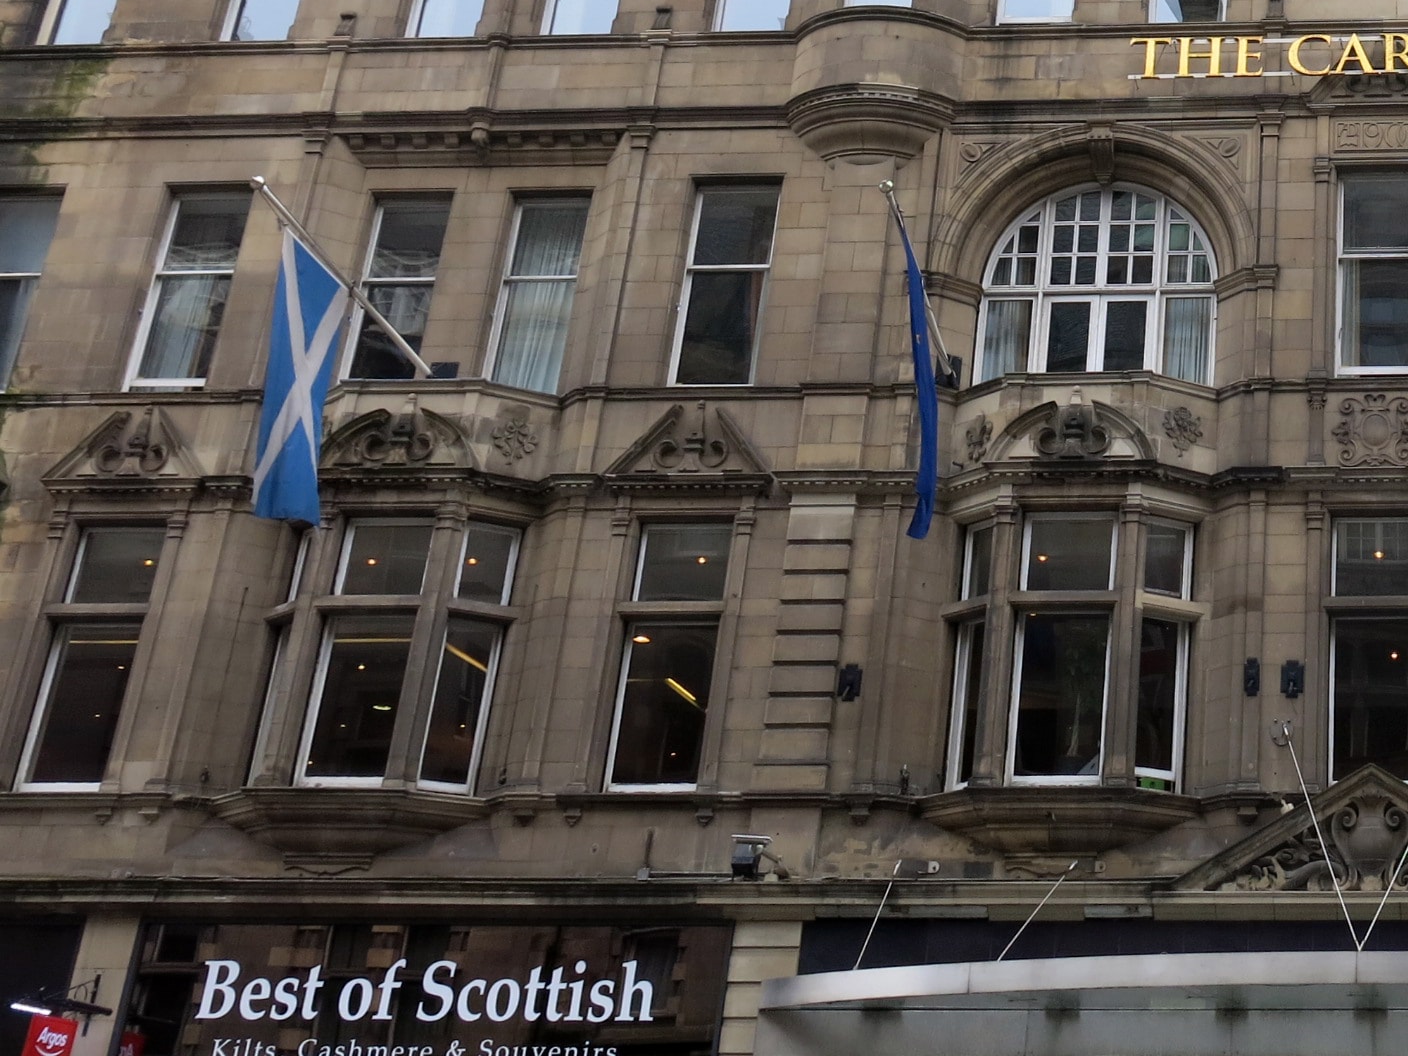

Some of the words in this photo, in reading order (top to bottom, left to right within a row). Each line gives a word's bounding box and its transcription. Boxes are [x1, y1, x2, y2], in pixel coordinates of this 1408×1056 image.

[1130, 35, 1264, 79] THE
[194, 959, 325, 1021] Best
[337, 958, 407, 1022] of
[415, 959, 655, 1023] Scottish
[36, 1026, 68, 1050] Argos
[210, 1038, 284, 1056] Kilts
[298, 1038, 433, 1056] Cashmere
[445, 1040, 466, 1056] &
[478, 1039, 618, 1056] Souvenirs
